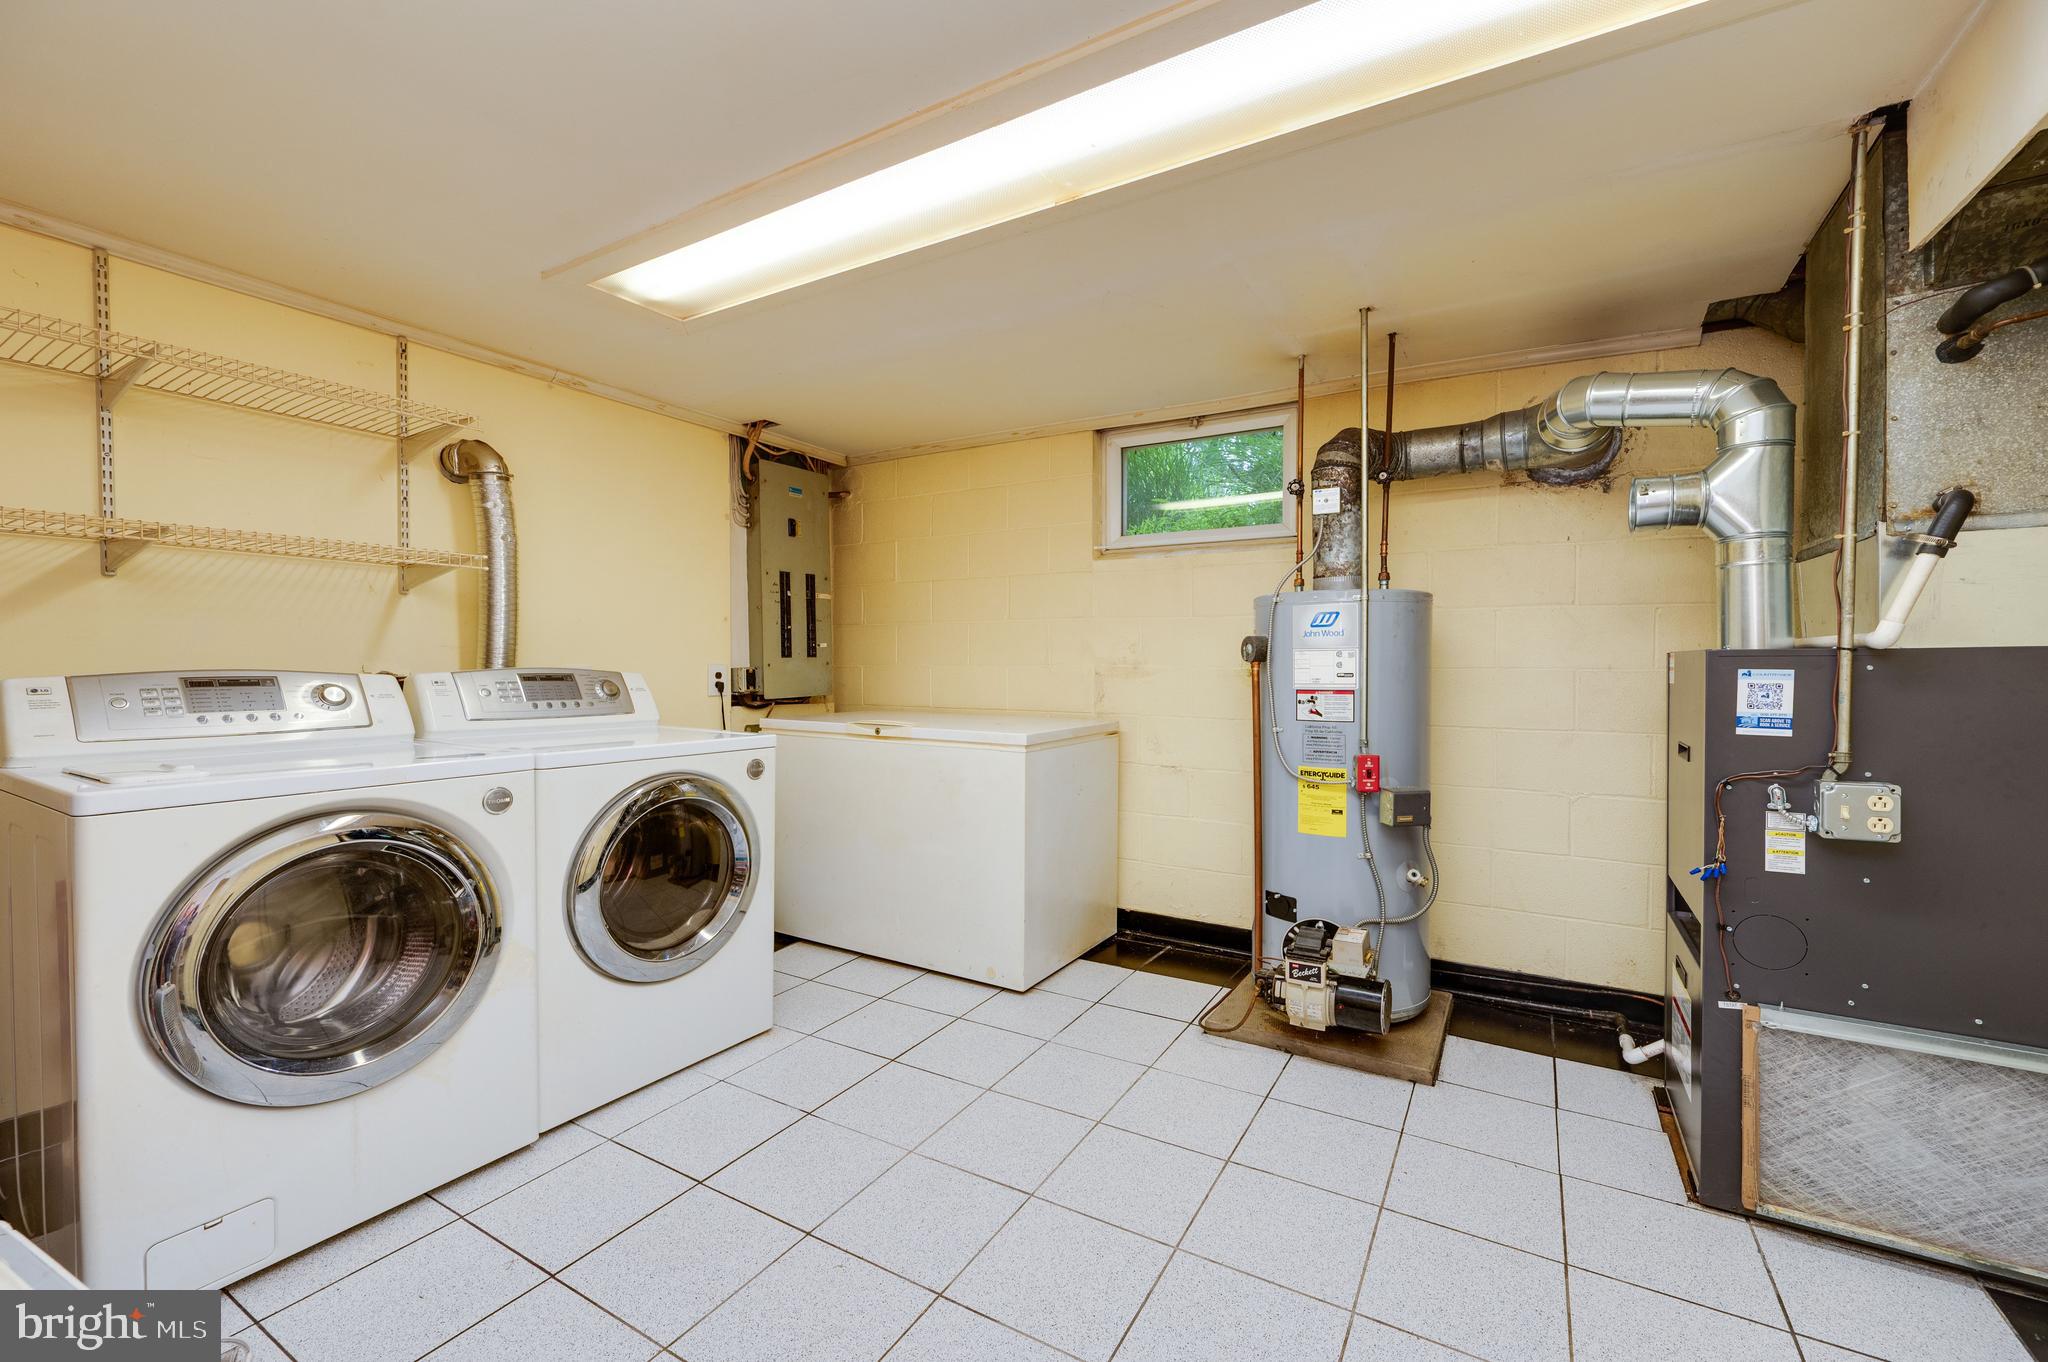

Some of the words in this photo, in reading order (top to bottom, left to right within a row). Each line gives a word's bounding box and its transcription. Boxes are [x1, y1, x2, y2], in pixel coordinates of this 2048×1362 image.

[1303, 629, 1320, 638] John
[1321, 628, 1344, 637] Wood
[1291, 967, 1319, 978] Beckett
